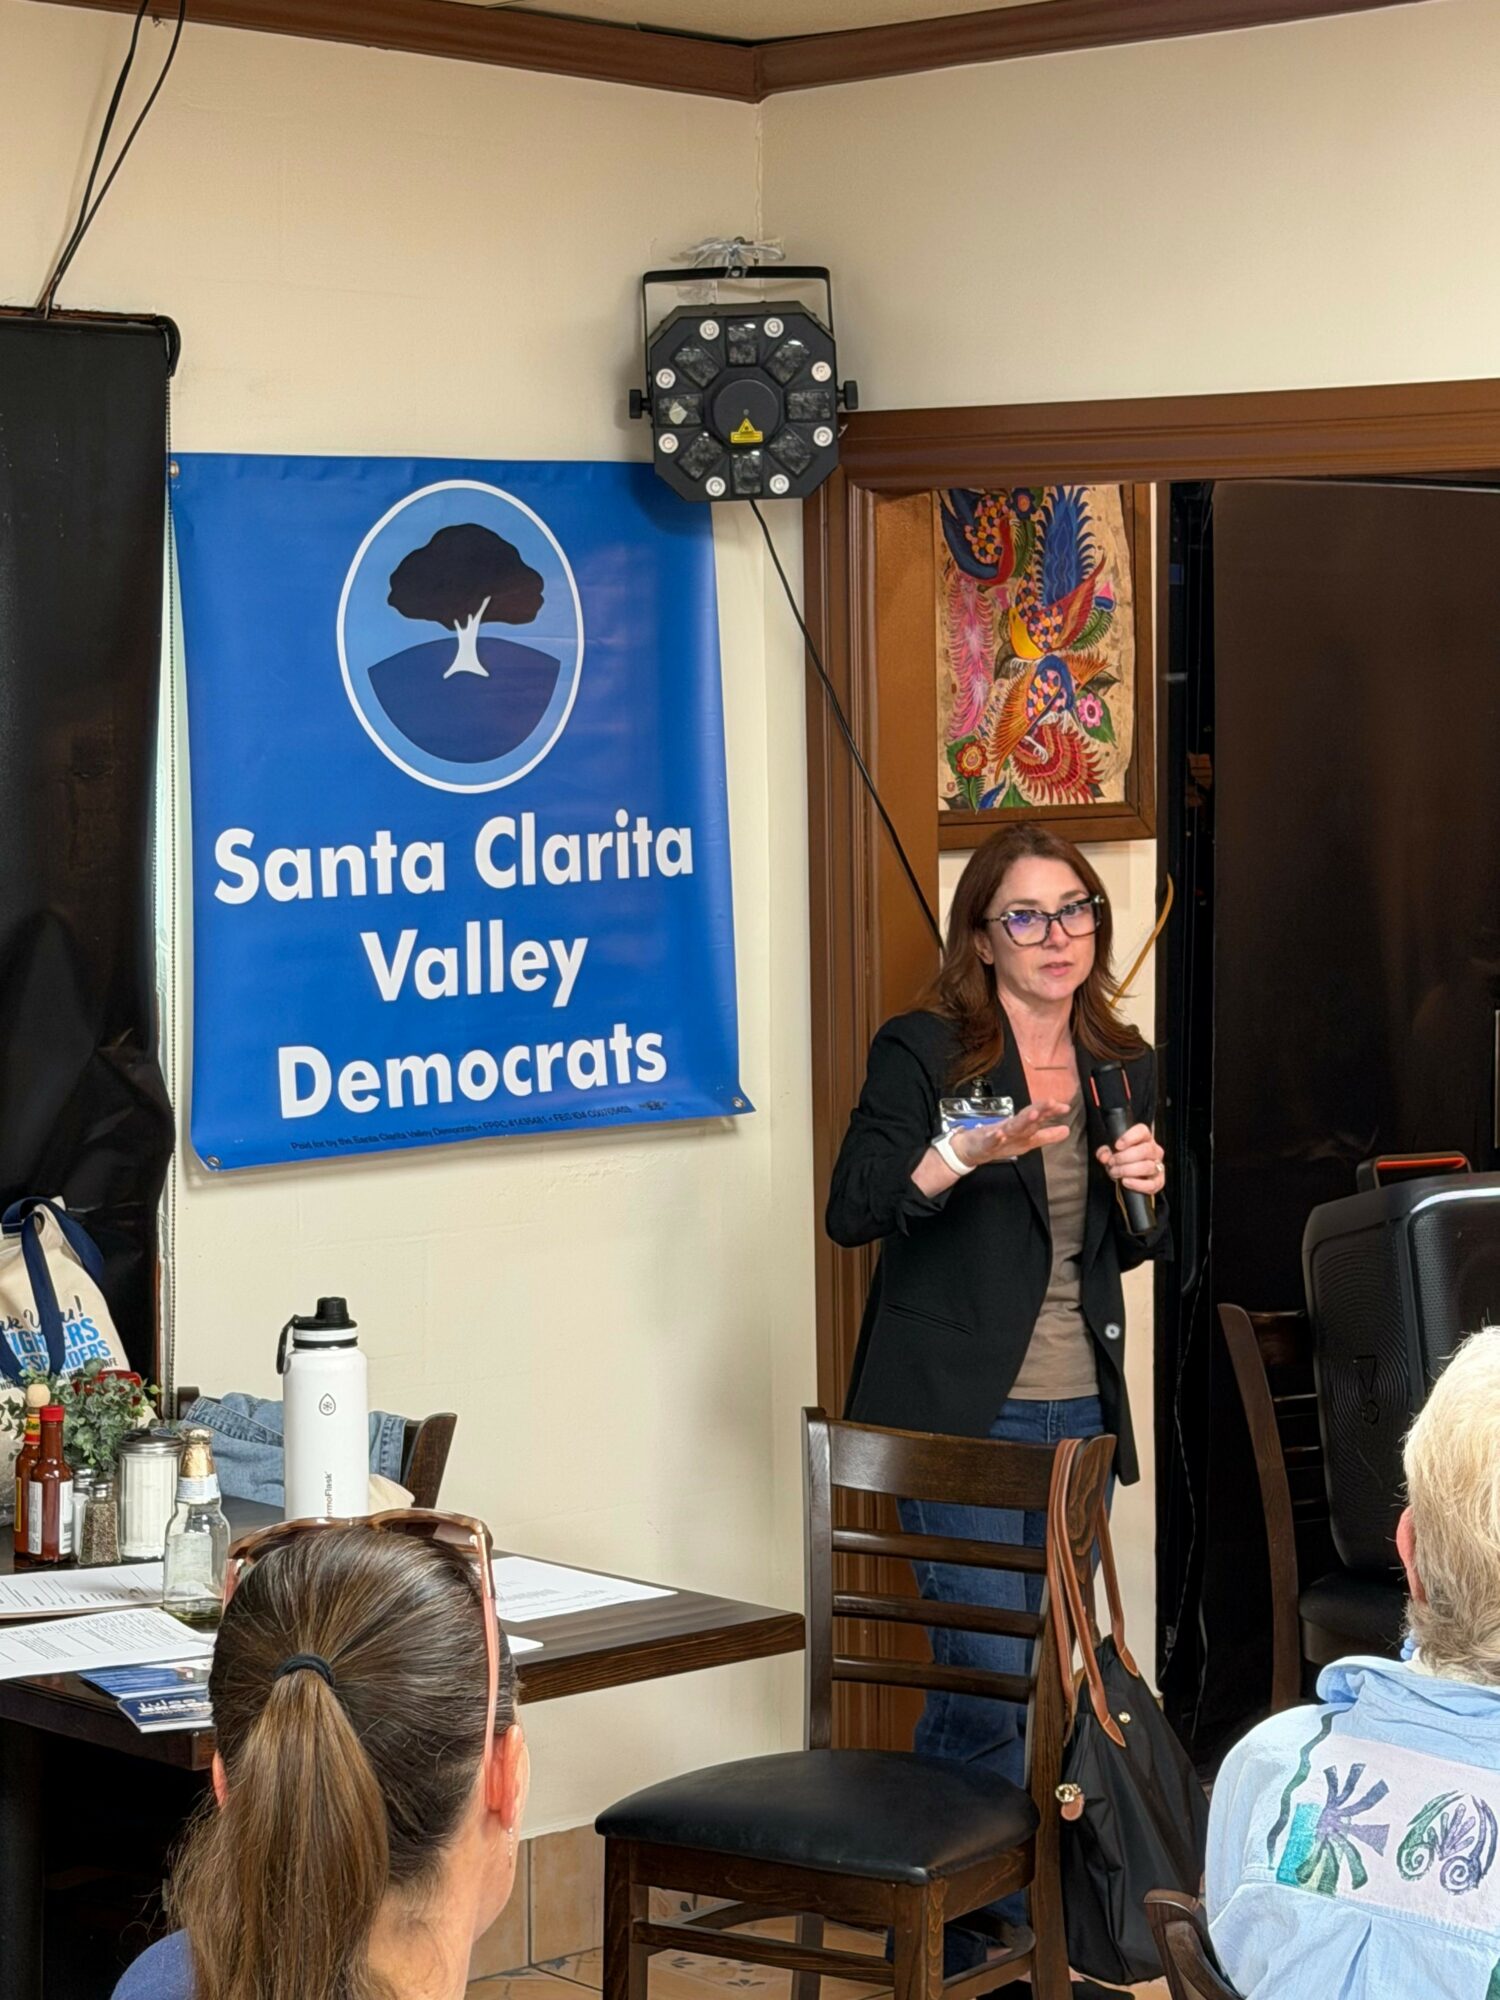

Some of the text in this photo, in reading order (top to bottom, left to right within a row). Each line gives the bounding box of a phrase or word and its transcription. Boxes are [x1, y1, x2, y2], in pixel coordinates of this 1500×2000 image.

[214, 809, 693, 904] Santa Clarita
[360, 919, 589, 1008] Valley
[278, 1023, 667, 1119] Democrats
